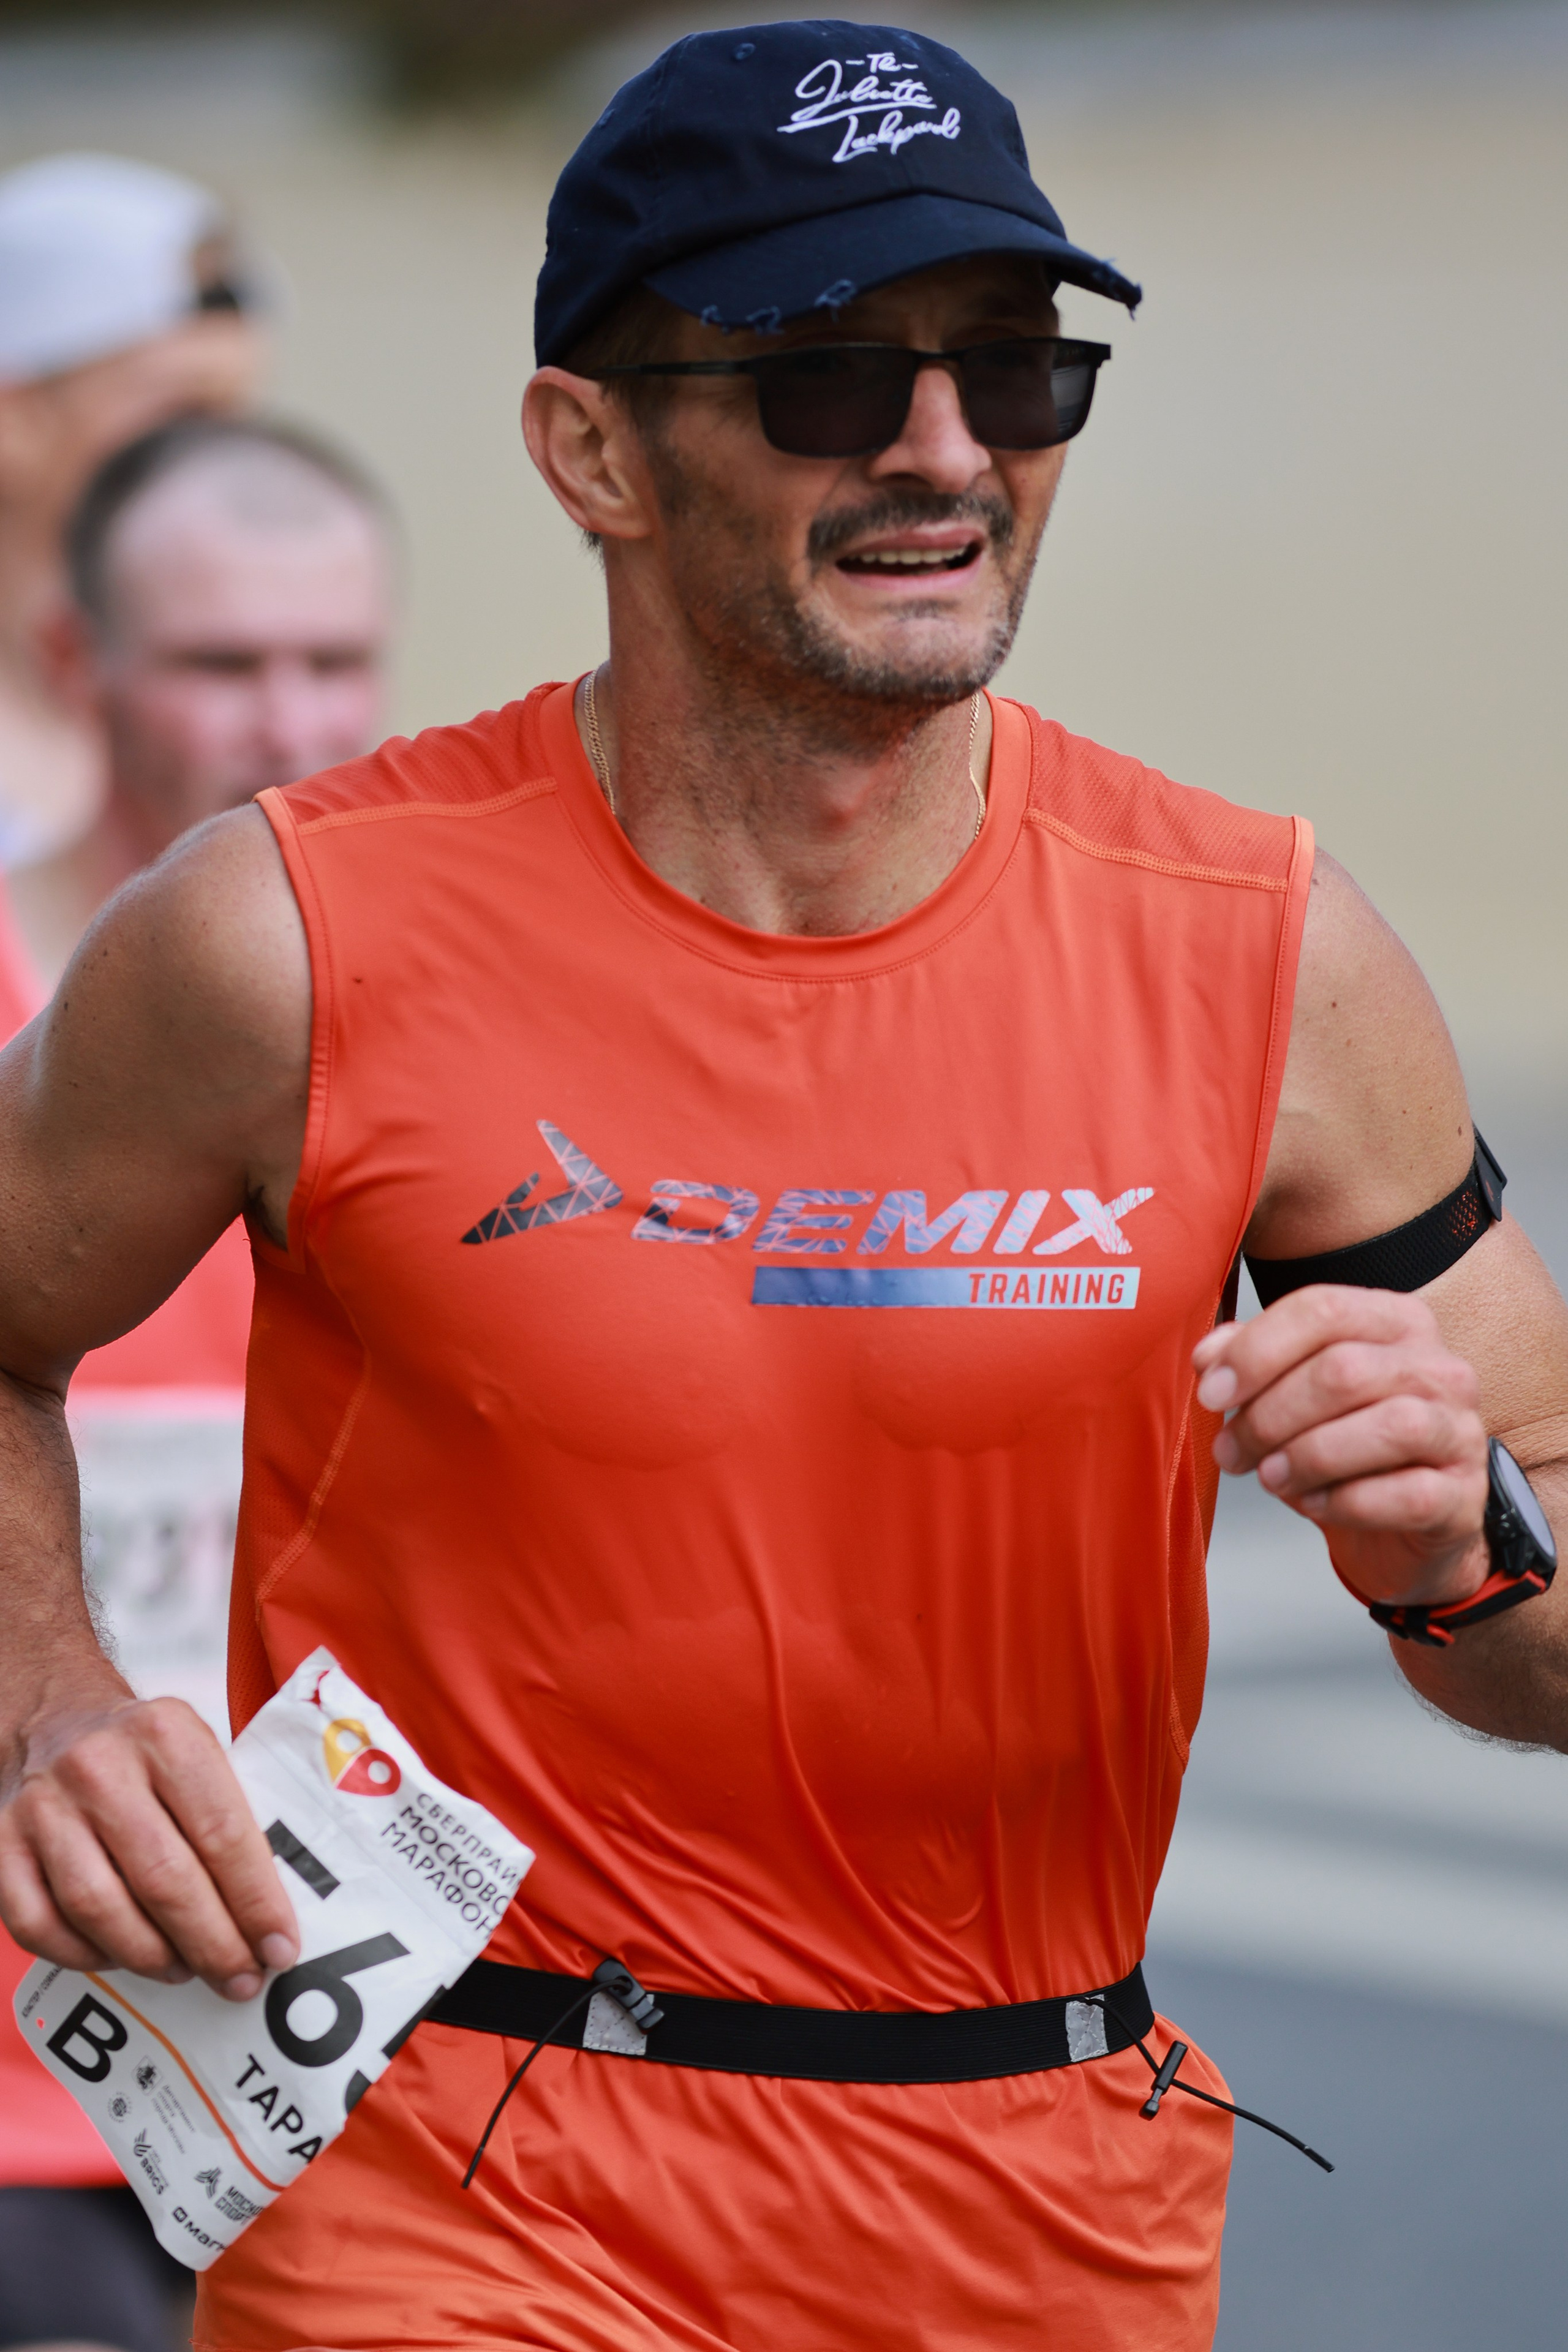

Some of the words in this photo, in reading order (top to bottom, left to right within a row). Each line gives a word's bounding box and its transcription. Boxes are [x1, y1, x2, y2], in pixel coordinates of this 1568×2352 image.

[631, 1180, 1156, 1256] DEMIX
[968, 1273, 1126, 1305] TRAINING
[380, 1822, 494, 1940] МАРАФОН
[417, 1793, 523, 1889] СБЕРПРАЙ
[236, 2053, 323, 2163] ТАРА
[141, 2158, 164, 2195] BRICS
